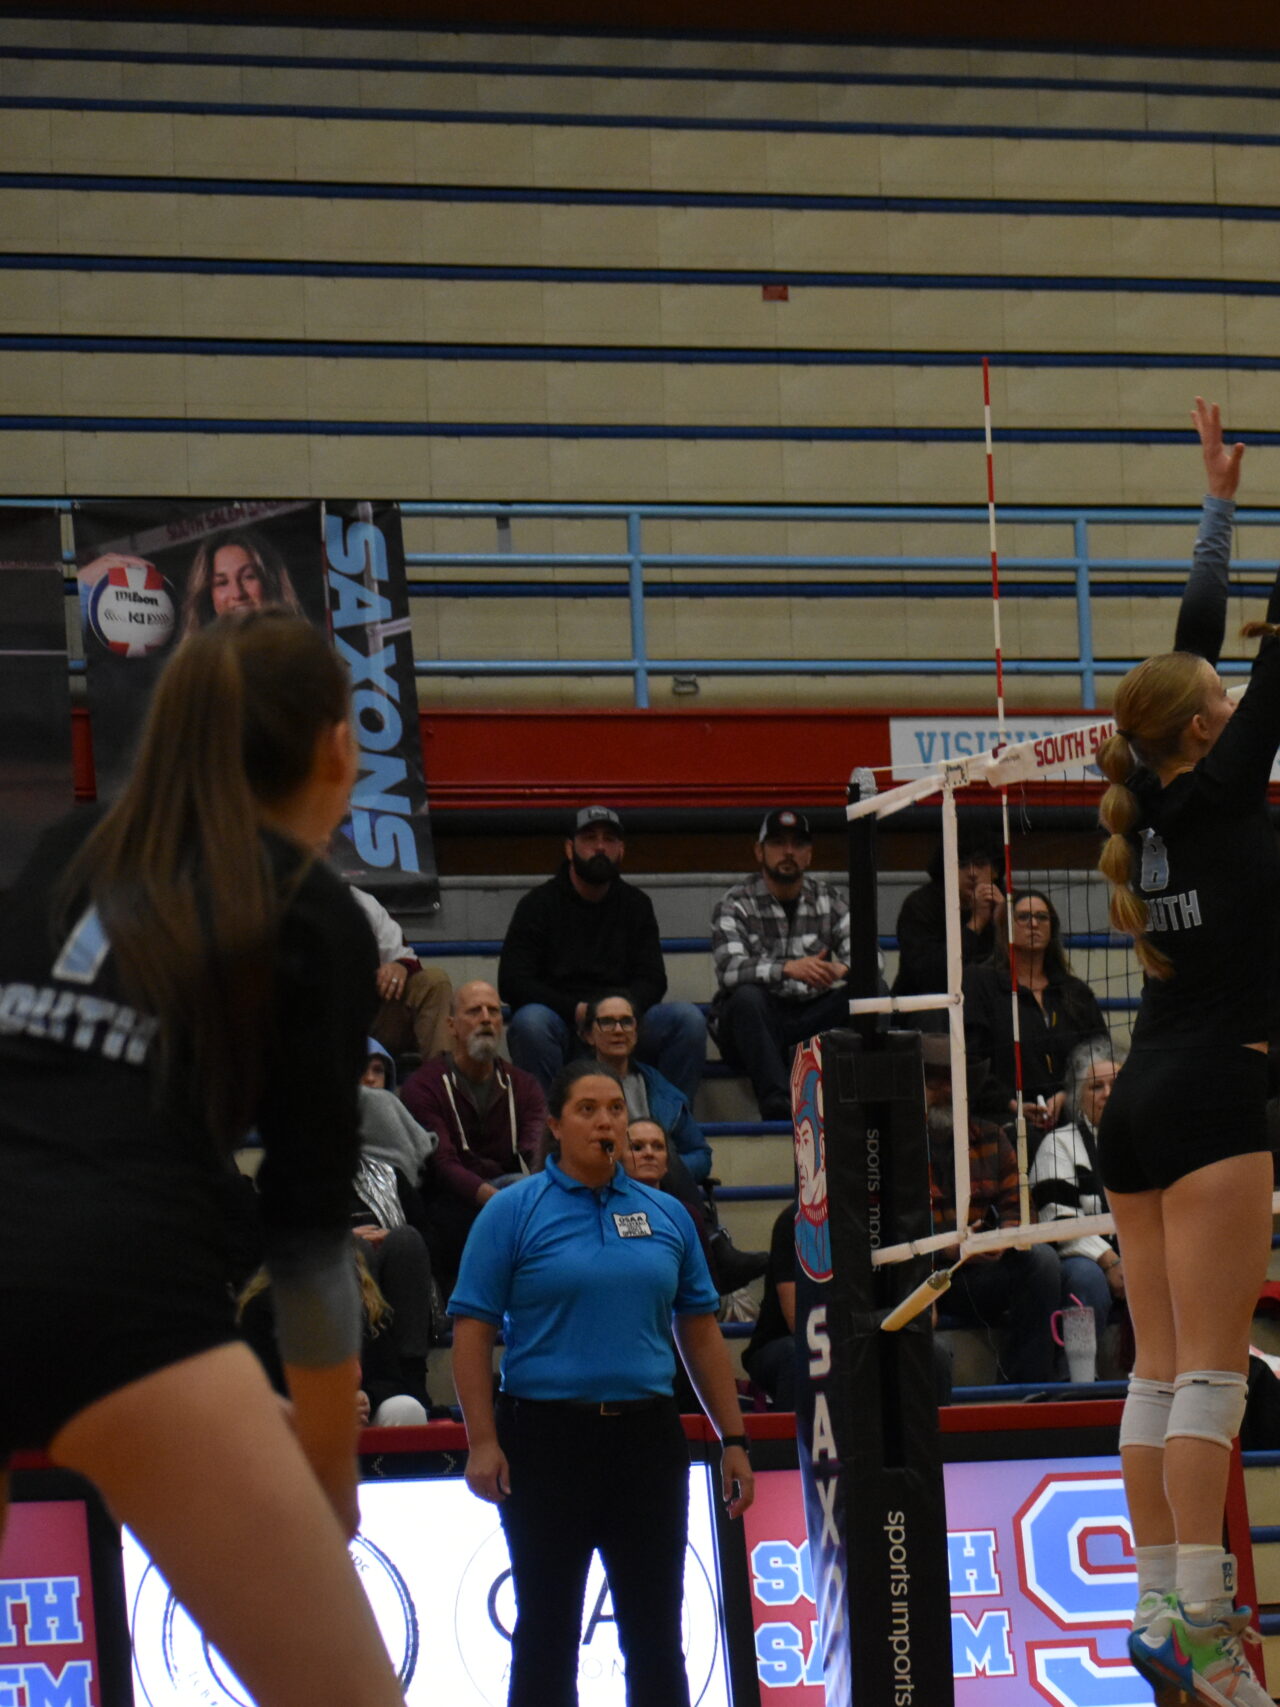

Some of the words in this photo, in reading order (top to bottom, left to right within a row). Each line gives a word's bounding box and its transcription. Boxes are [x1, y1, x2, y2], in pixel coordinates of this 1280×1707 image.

[325, 513, 421, 873] SAXONS
[1033, 731, 1086, 768] SOUTH
[883, 1510, 911, 1597] sports
